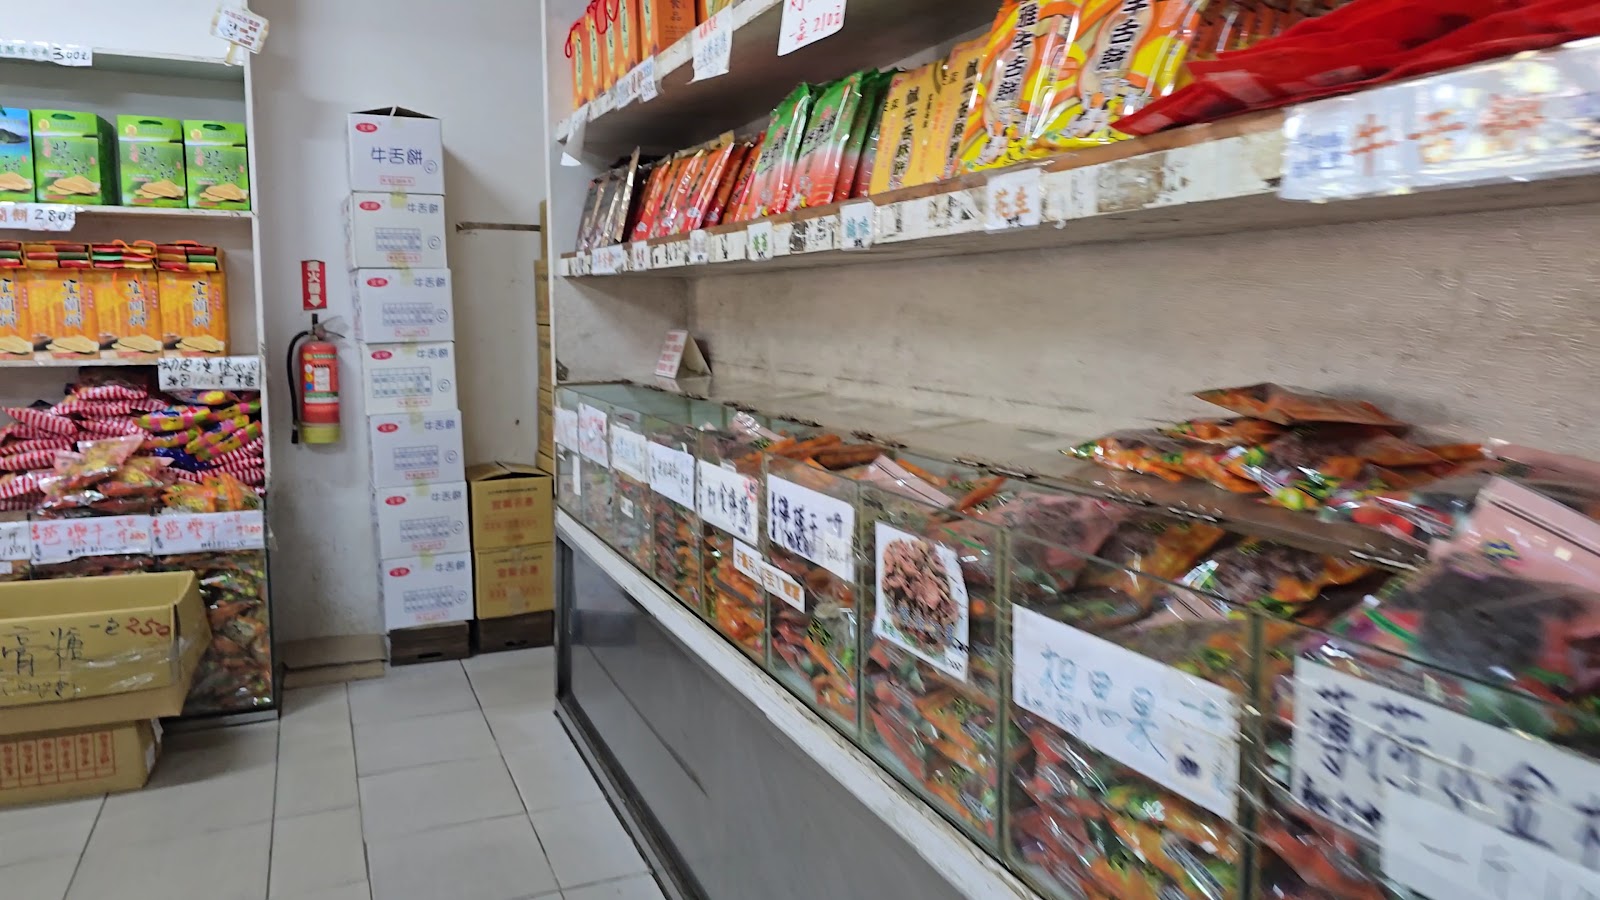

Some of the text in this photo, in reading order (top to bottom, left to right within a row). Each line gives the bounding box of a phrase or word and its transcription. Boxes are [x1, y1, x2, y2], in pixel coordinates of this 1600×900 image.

[371, 146, 423, 166] 牛舌餅
[125, 616, 170, 637] 250
